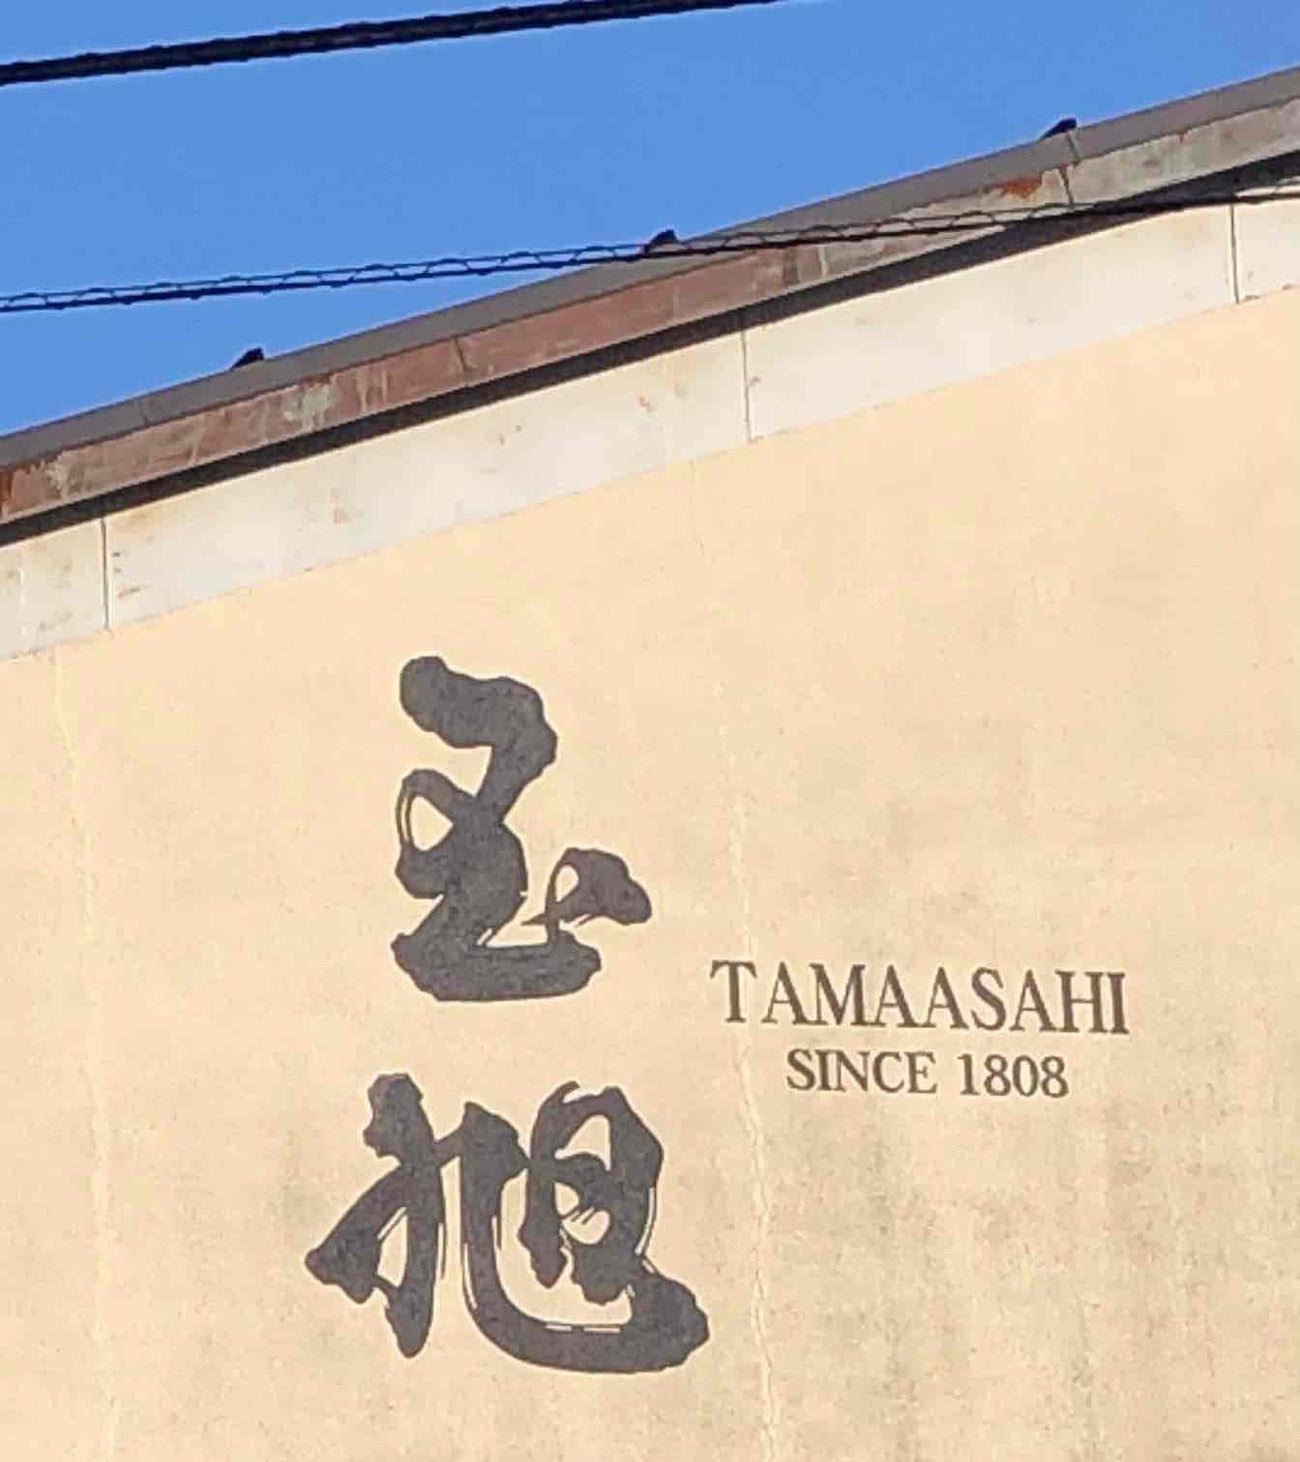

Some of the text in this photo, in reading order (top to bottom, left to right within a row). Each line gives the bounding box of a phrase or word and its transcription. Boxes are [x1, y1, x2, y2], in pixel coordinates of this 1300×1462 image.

[710, 959, 1130, 1036] TAMAASAHI
[786, 1048, 1070, 1099] SINCE 1808
